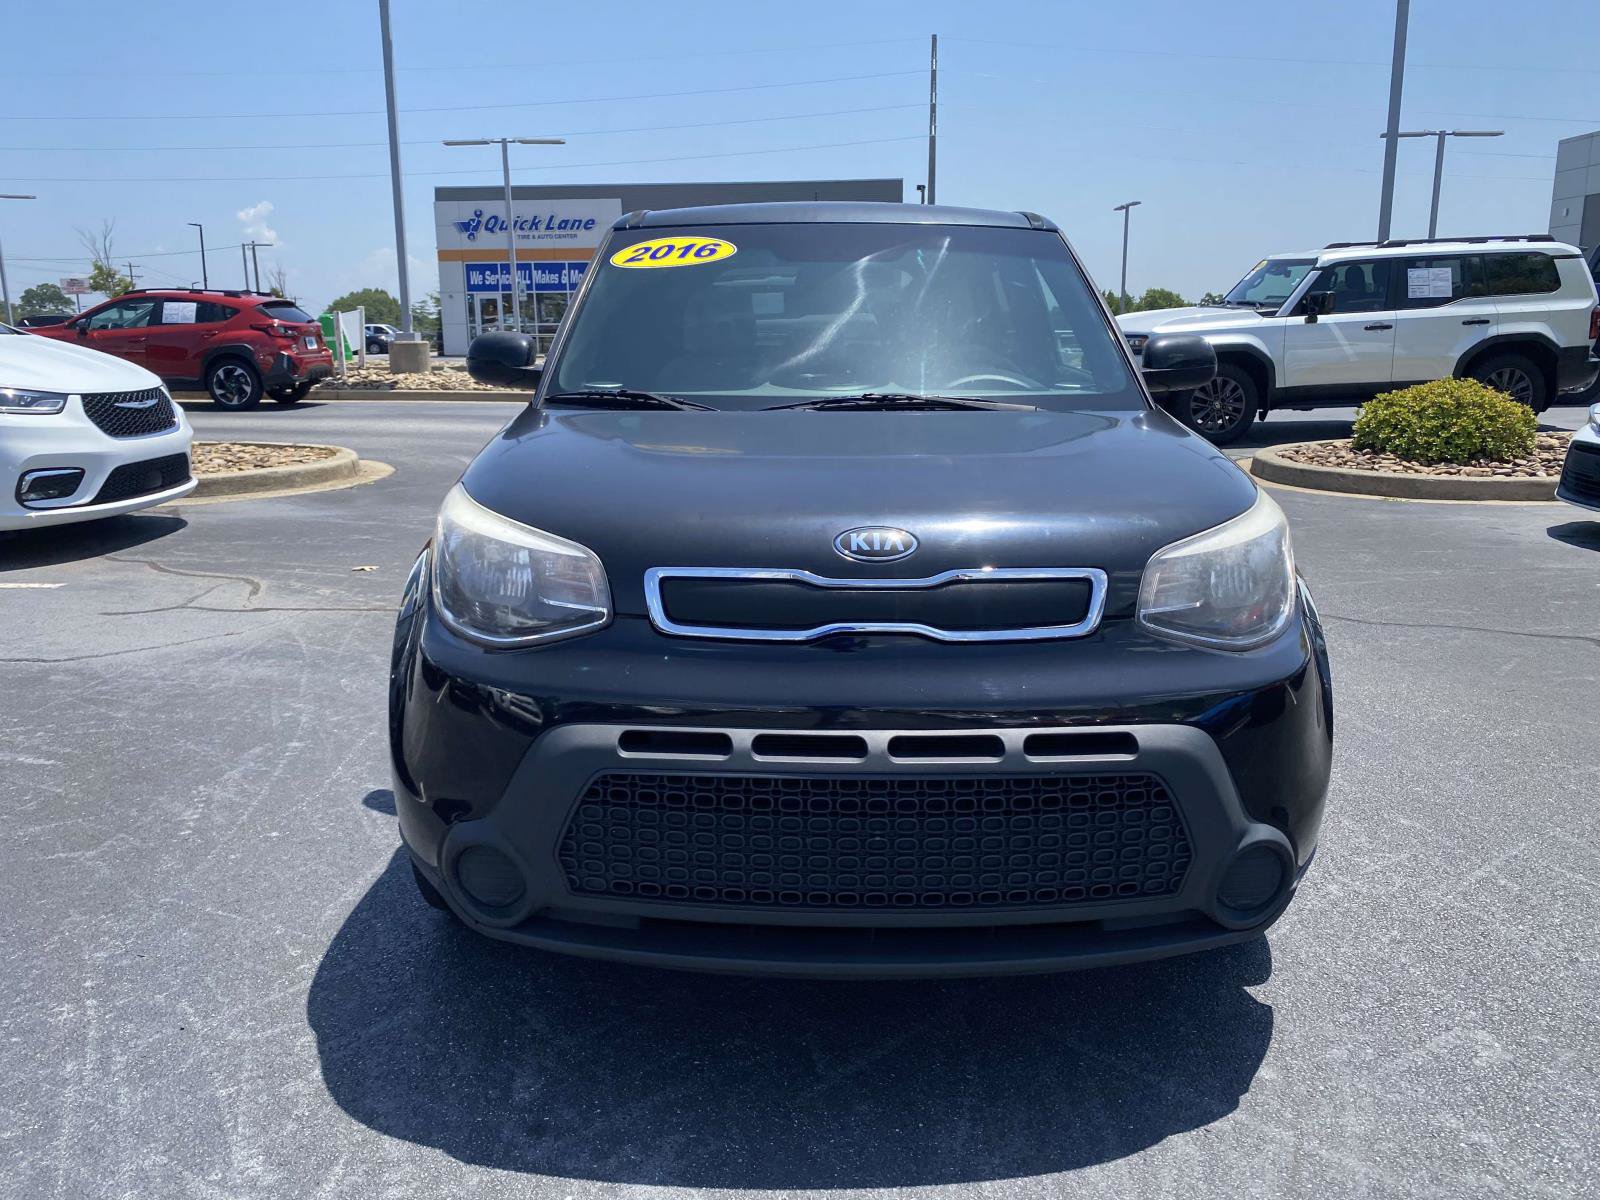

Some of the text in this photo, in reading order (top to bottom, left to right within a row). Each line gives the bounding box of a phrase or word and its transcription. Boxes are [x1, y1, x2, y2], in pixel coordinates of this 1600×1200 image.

[484, 214, 596, 233] Quick Lane
[623, 243, 722, 264] 2016
[470, 270, 483, 285] We
[516, 270, 531, 284] ALL
[534, 269, 559, 284] Makes
[561, 269, 568, 284] &
[849, 532, 904, 551] KIA
